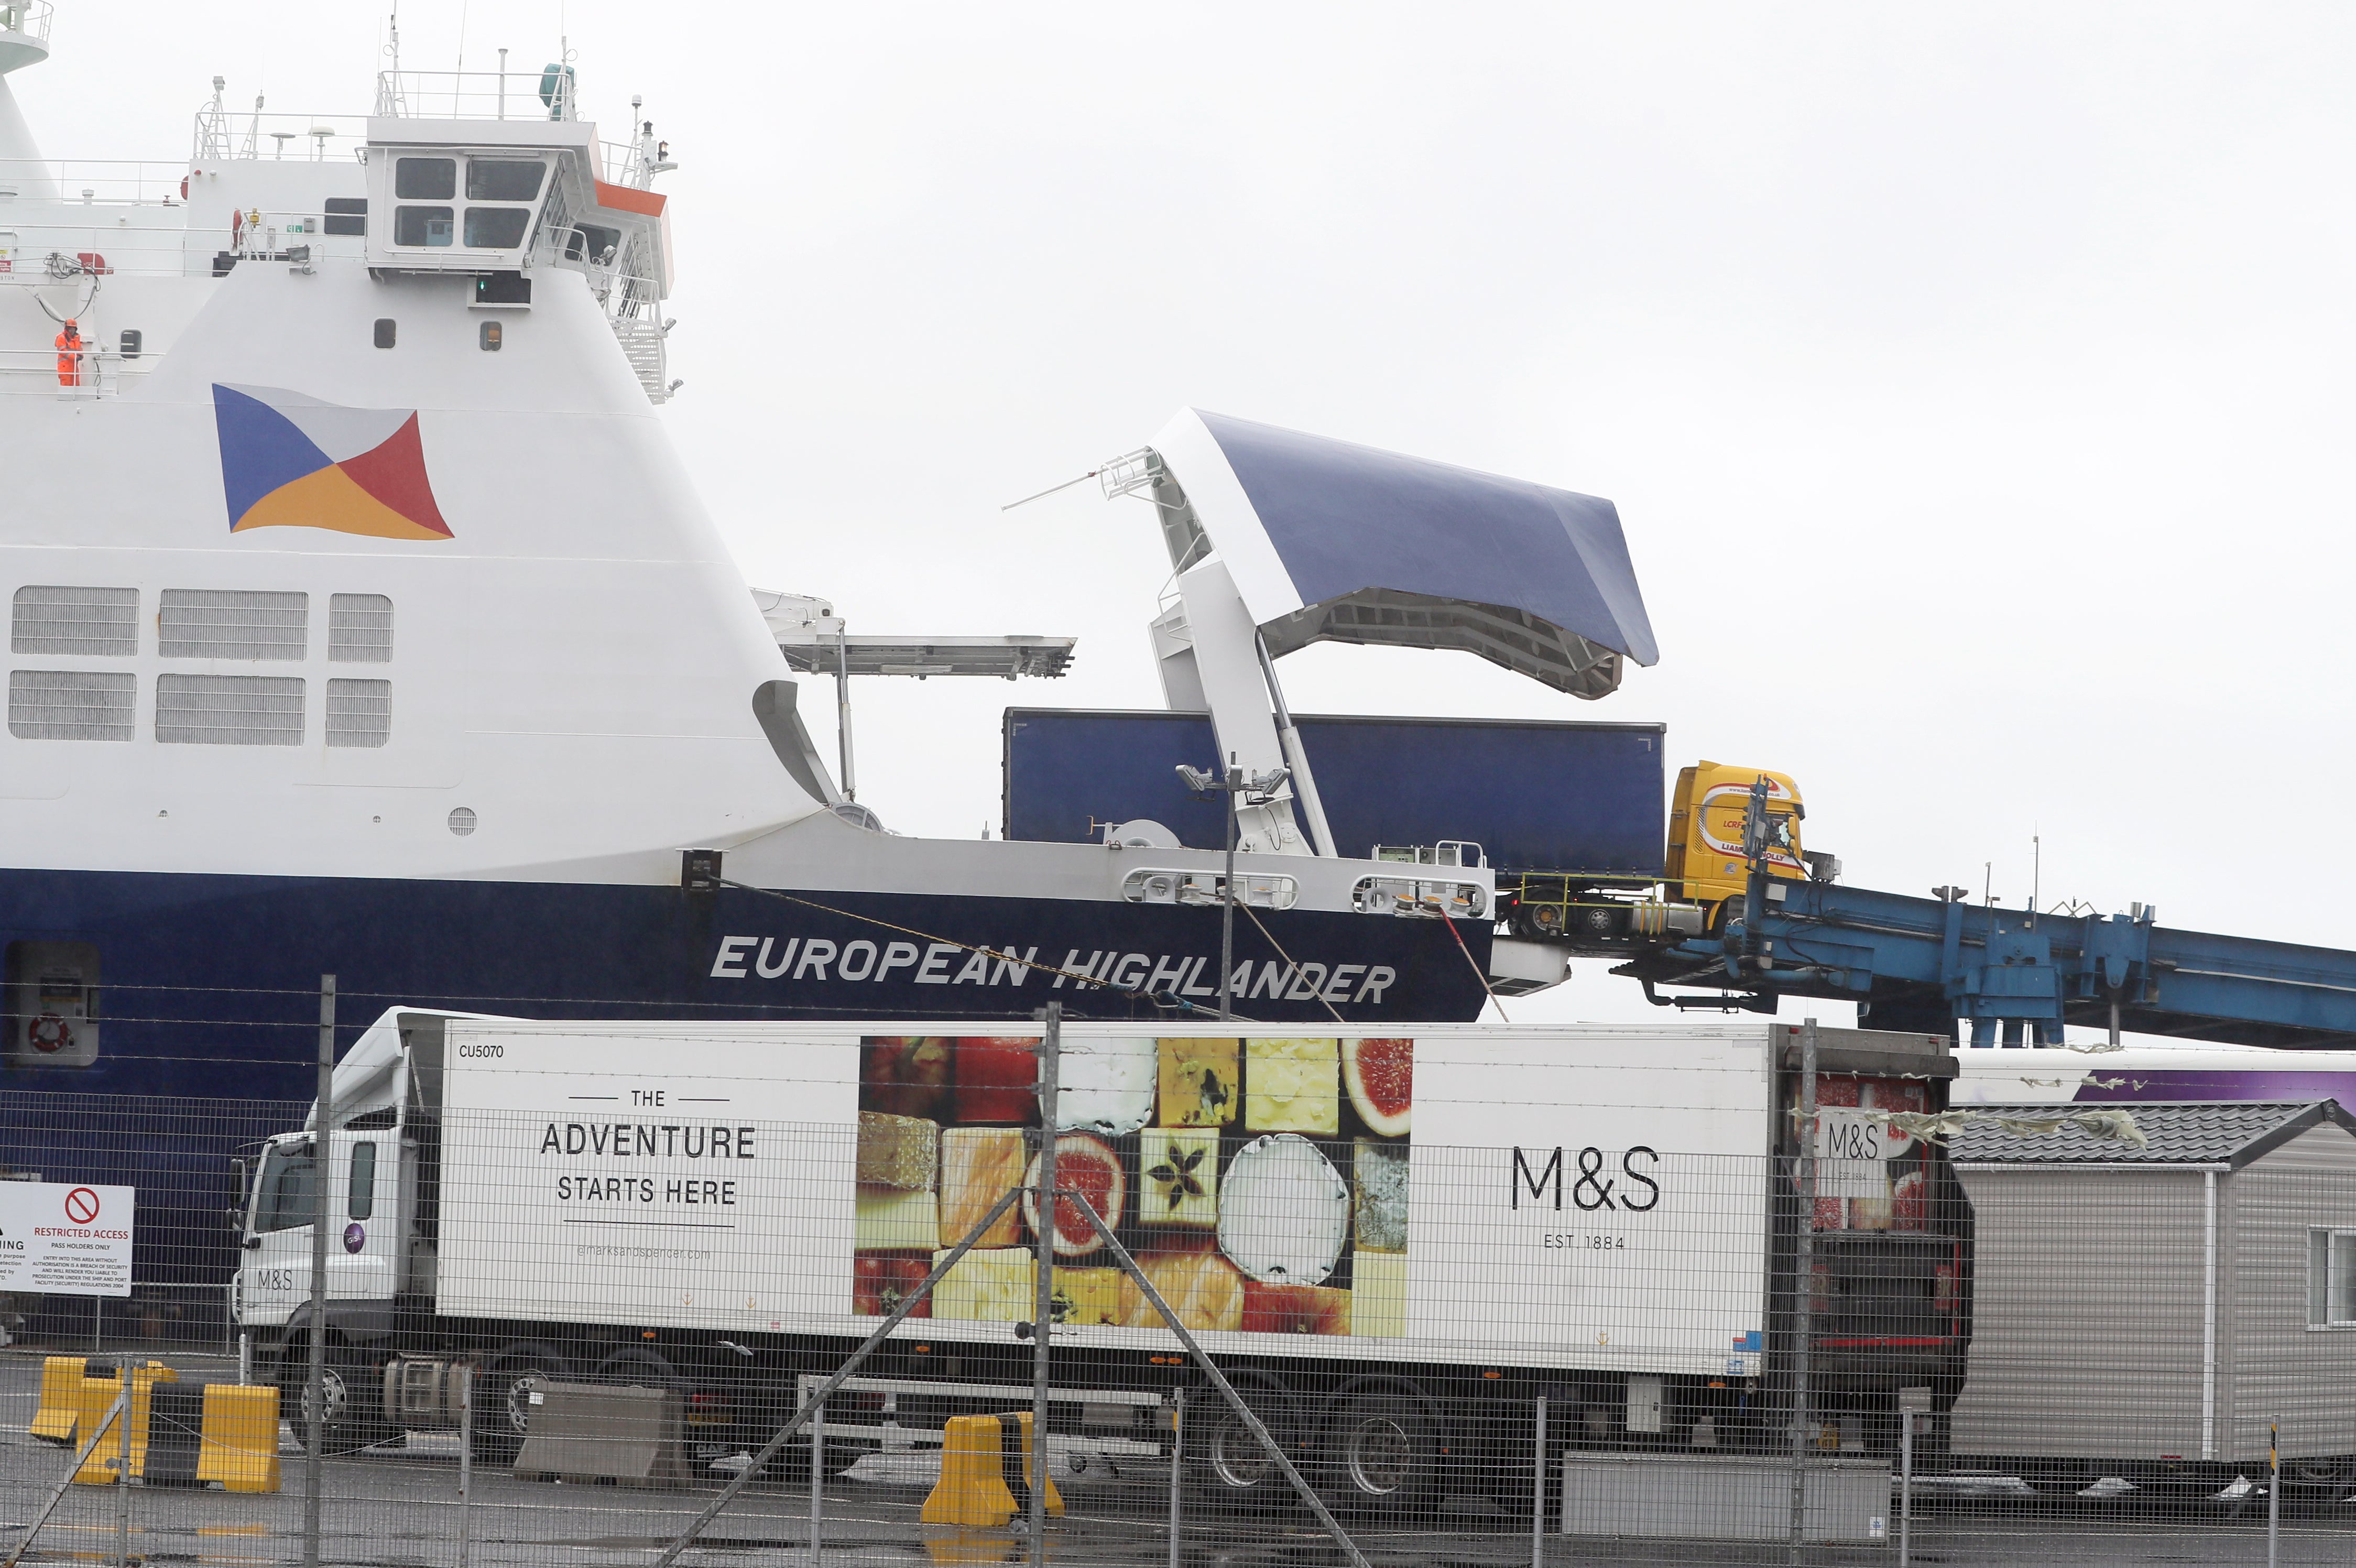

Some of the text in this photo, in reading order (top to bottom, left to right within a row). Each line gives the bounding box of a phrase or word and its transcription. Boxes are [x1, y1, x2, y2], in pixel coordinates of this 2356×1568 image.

[710, 935, 1039, 987] EUROPEAN
[1052, 949, 1396, 1004] HIGHLANDER
[460, 1045, 504, 1058] CU5070
[631, 1090, 665, 1107] THE
[540, 1124, 755, 1159] ADVENTURE
[1829, 1123, 1878, 1159] M&S
[1512, 1146, 1660, 1212] M&S
[558, 1176, 735, 1205] STARTS HERE
[34, 1227, 128, 1239] RESTRICTED ACCESS
[1585, 1235, 1624, 1250] 1884
[0, 1240, 24, 1250] ING
[258, 1269, 292, 1291] M&S
[696, 1444, 728, 1453] DAF
